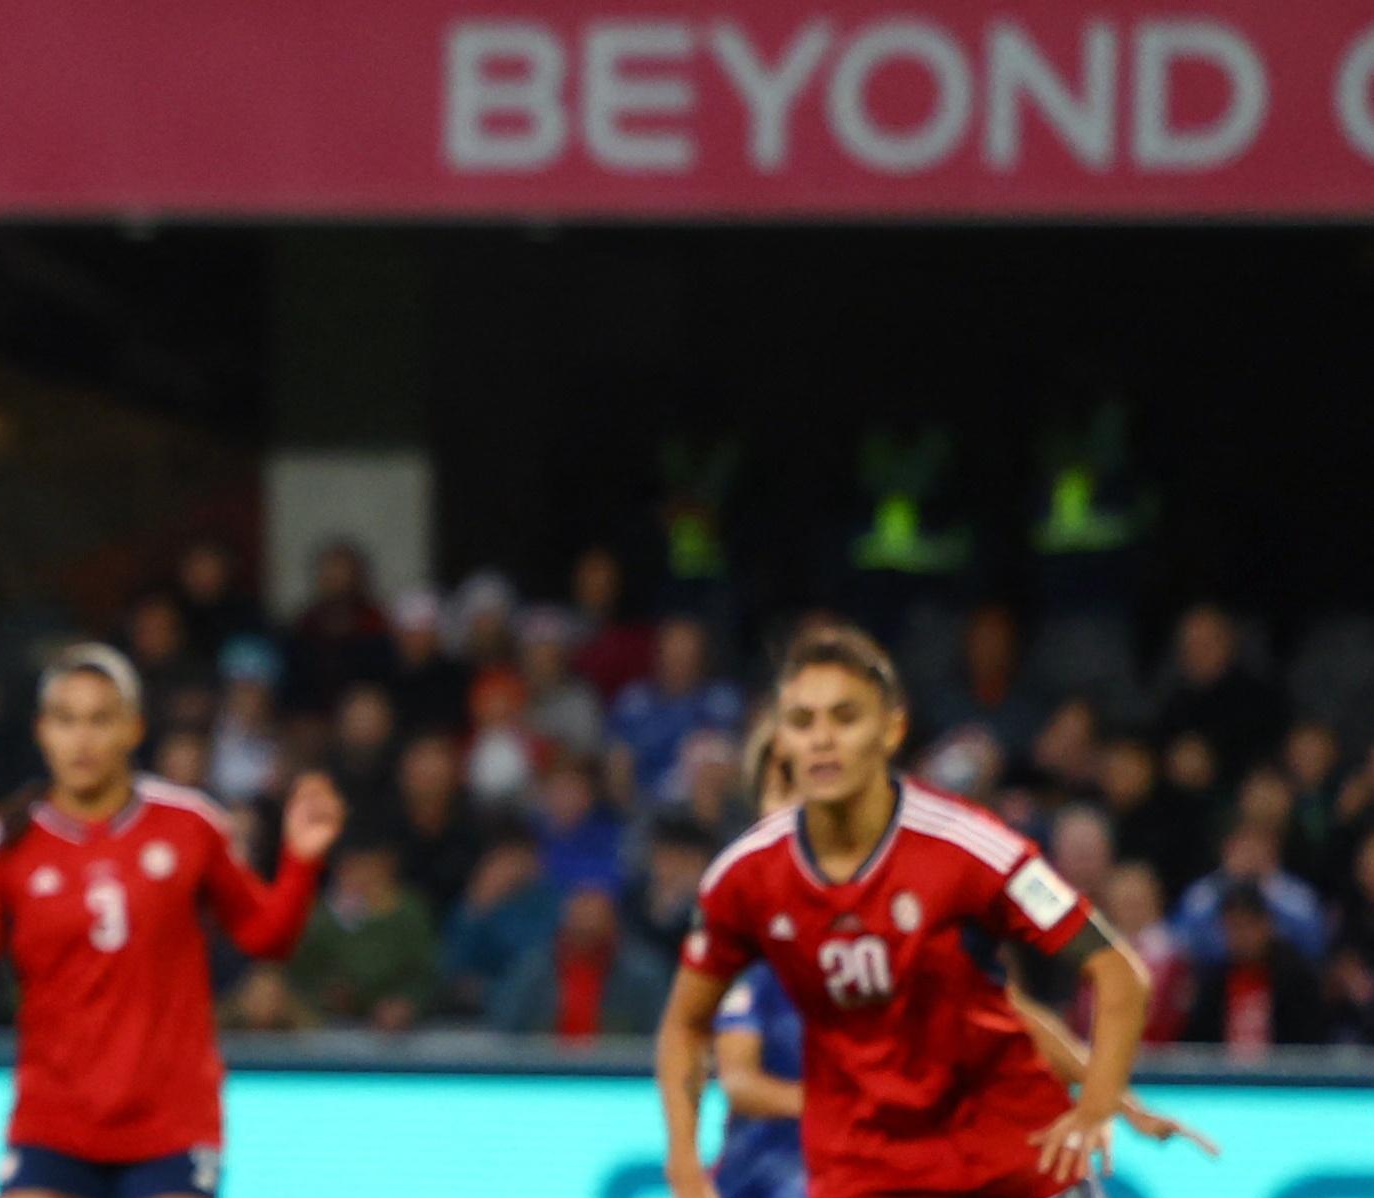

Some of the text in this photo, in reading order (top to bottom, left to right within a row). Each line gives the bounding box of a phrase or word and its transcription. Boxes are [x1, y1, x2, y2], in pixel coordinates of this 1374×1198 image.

[443, 16, 1269, 174] BEYOND
[85, 880, 128, 953] 3
[818, 935, 893, 1006] 20
